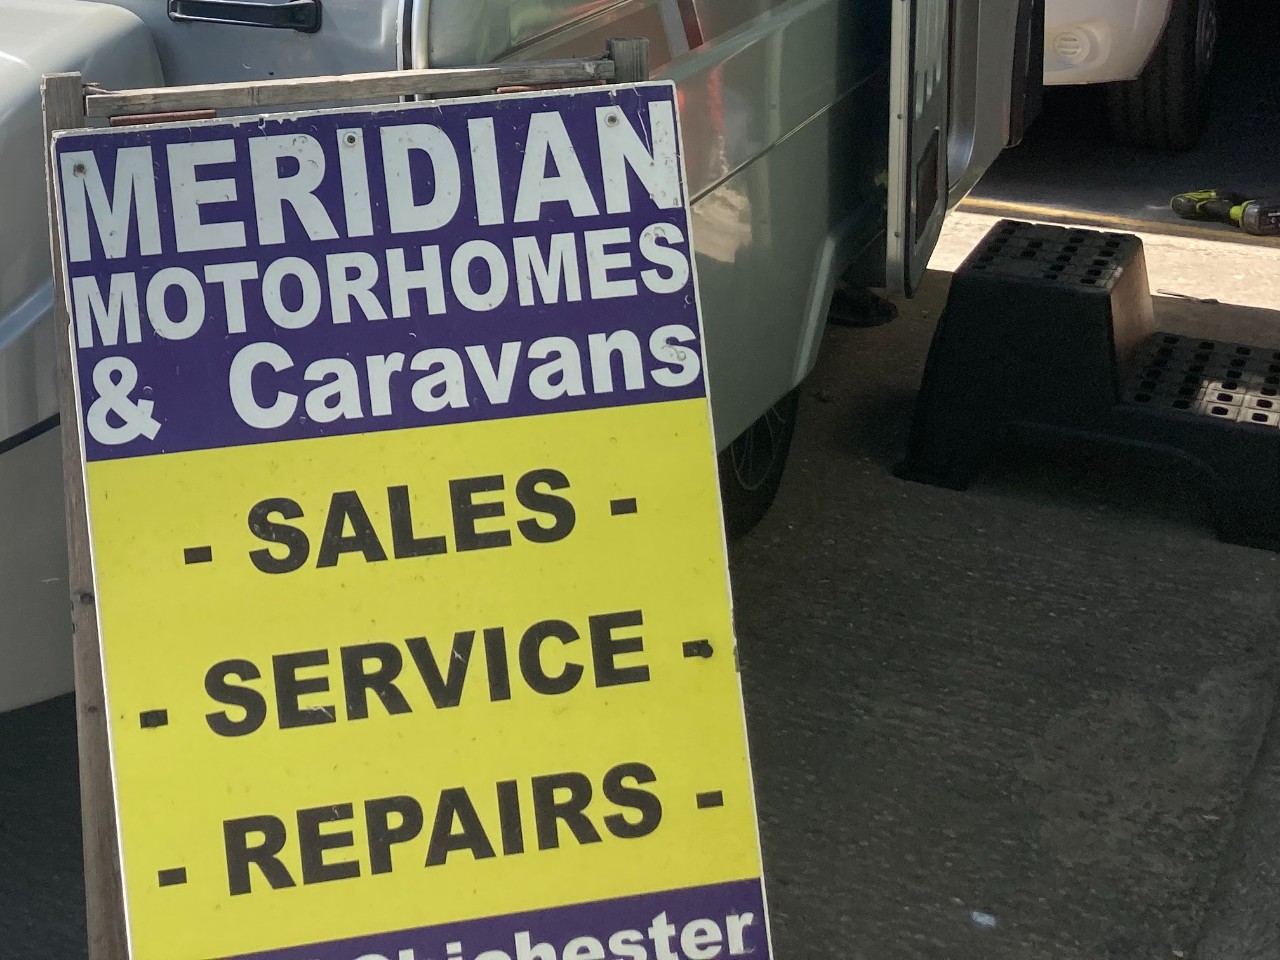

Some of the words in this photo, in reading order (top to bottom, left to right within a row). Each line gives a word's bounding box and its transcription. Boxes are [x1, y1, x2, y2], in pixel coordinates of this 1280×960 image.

[59, 100, 683, 263] MERIDIAN
[70, 222, 690, 349] MOTORHOMES
[86, 356, 162, 446] &
[228, 324, 701, 429] Caravans
[247, 468, 577, 575] SALES
[204, 609, 651, 738] SERVICE
[223, 762, 664, 897] REPAIRS
